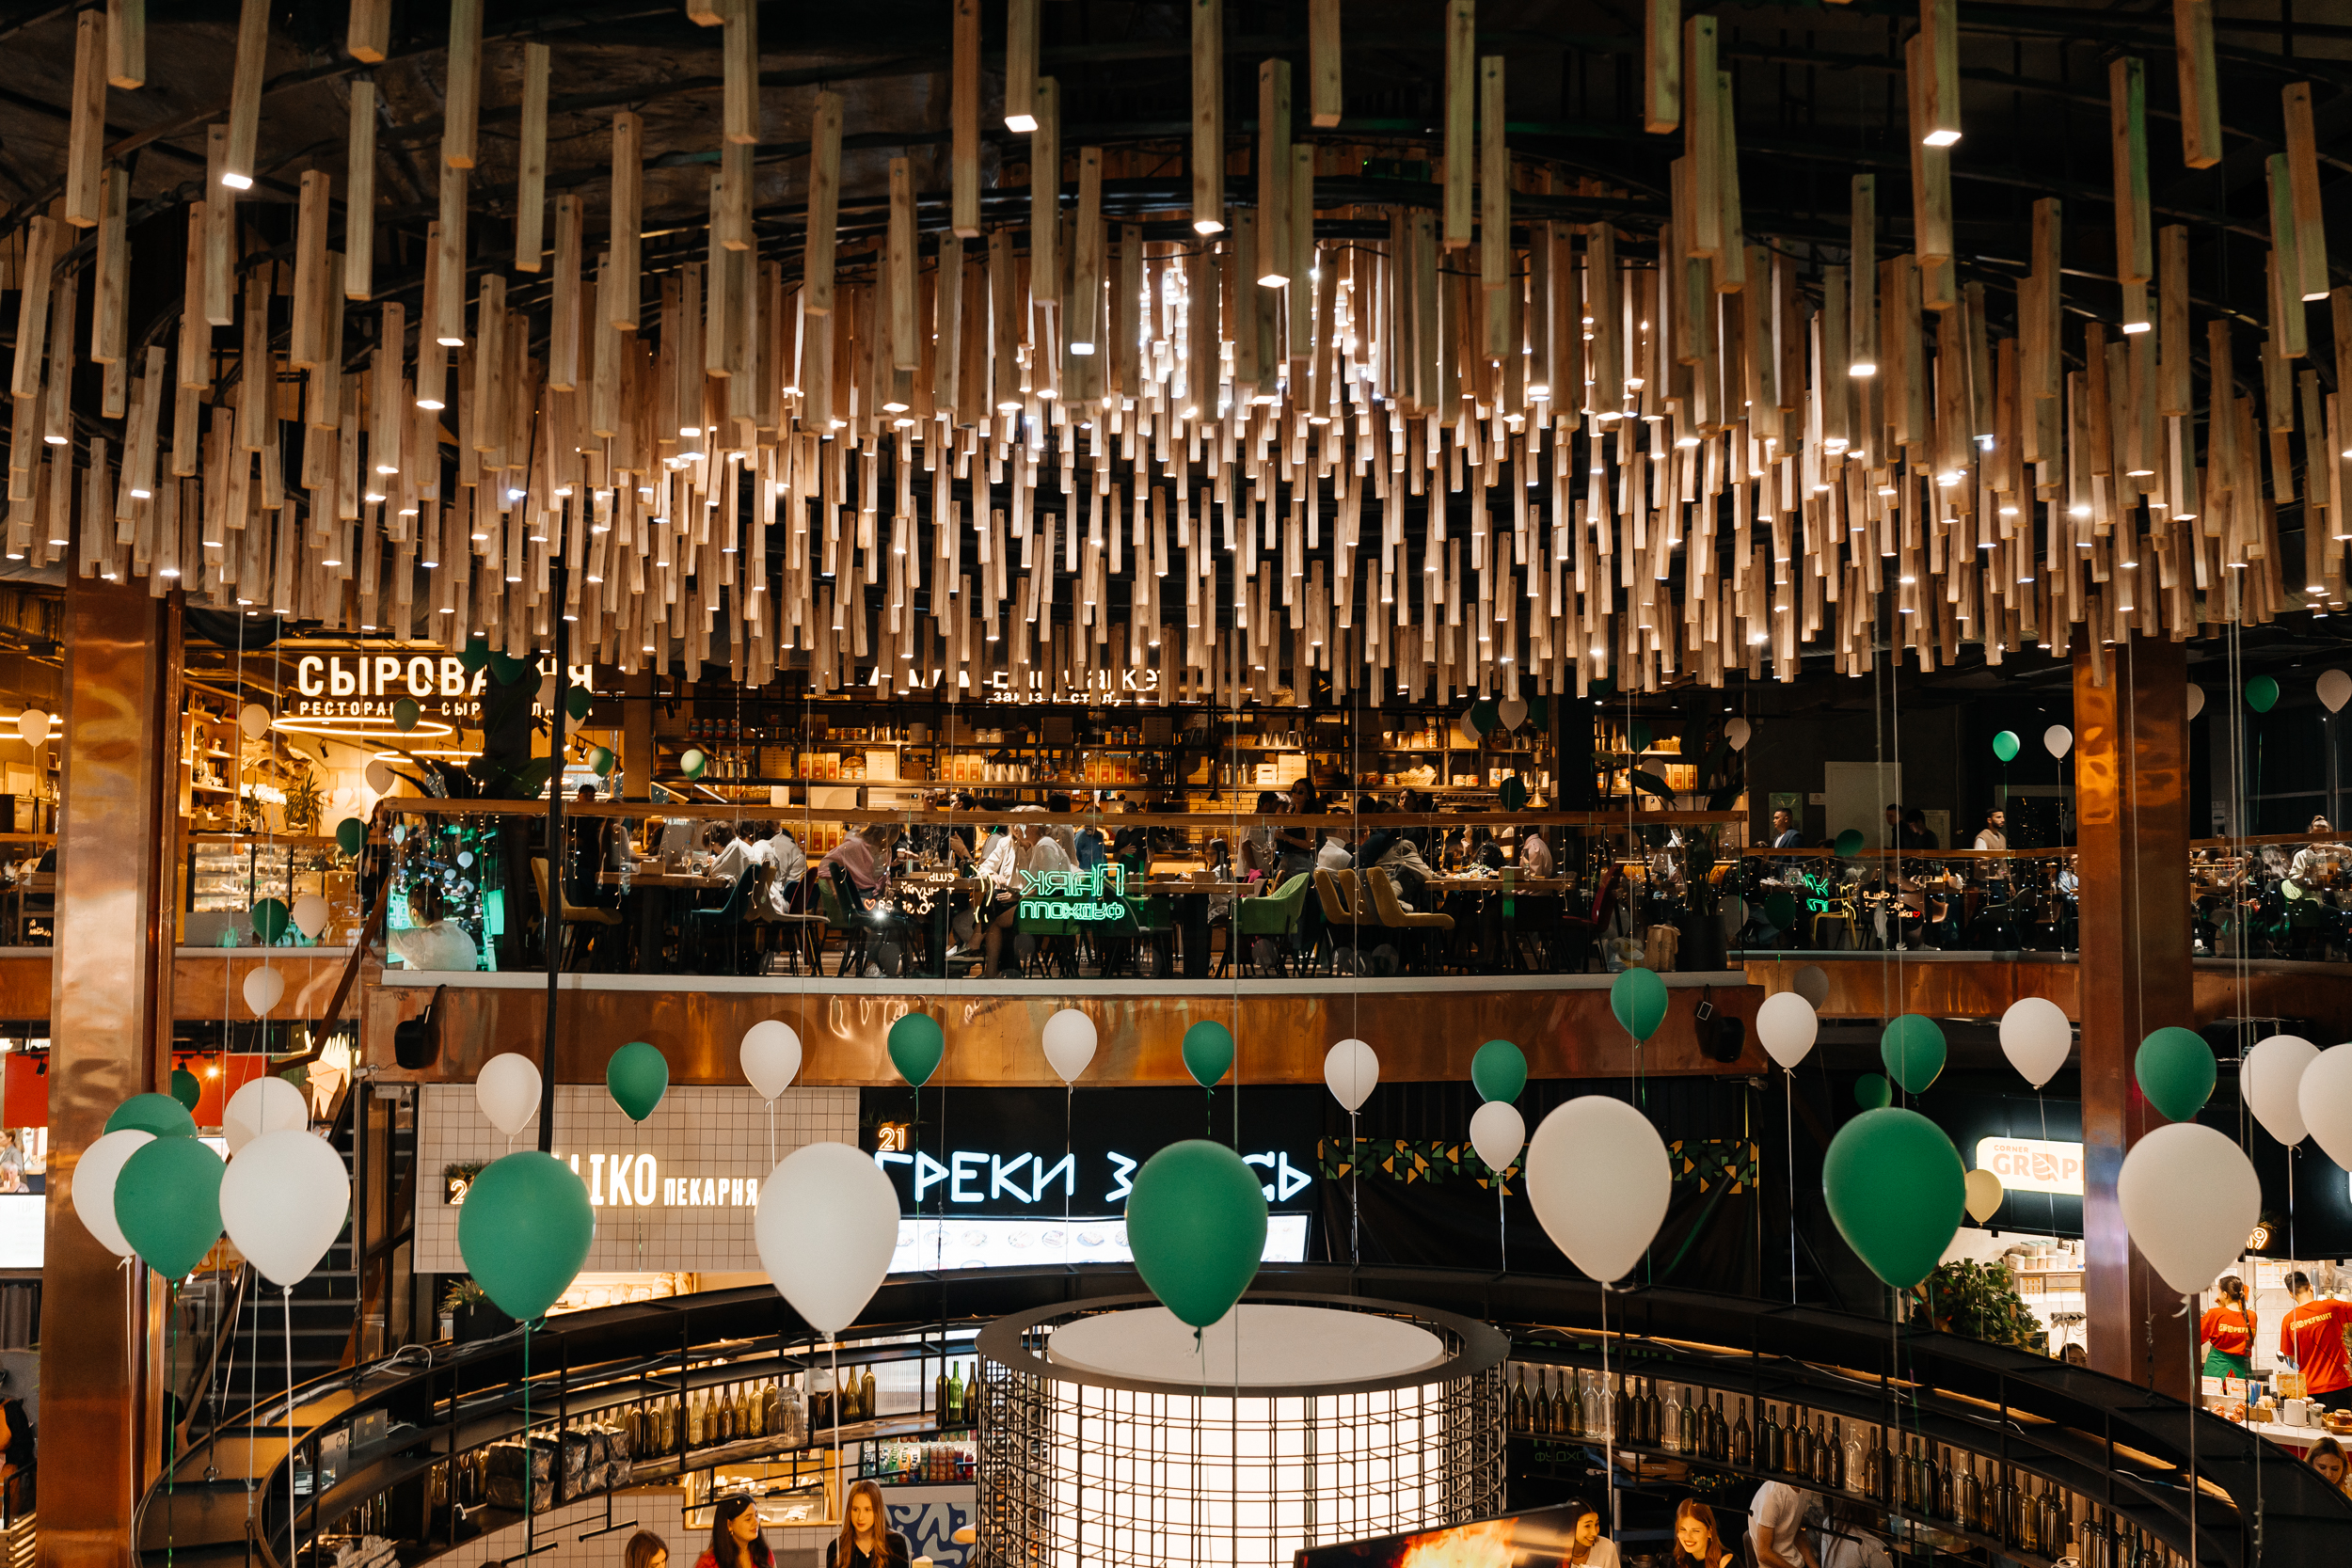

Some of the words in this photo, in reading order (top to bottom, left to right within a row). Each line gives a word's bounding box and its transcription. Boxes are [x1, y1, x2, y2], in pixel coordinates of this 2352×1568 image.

[298, 656, 593, 696] СЫРОВАЯ
[299, 701, 395, 716] РЕСТОРА
[441, 701, 482, 716] СЫР
[993, 691, 1042, 703] закз
[1071, 689, 1120, 707] стлу
[878, 1127, 906, 1151] 21
[1994, 1145, 2029, 1153] CORNER
[569, 1153, 658, 1206] IKO
[663, 1178, 758, 1207] ПЕКАРНЯ
[1104, 1150, 1312, 1202] ЗСЬ
[450, 1180, 469, 1205] 2
[1534, 1450, 1587, 1463] ФУДХО
